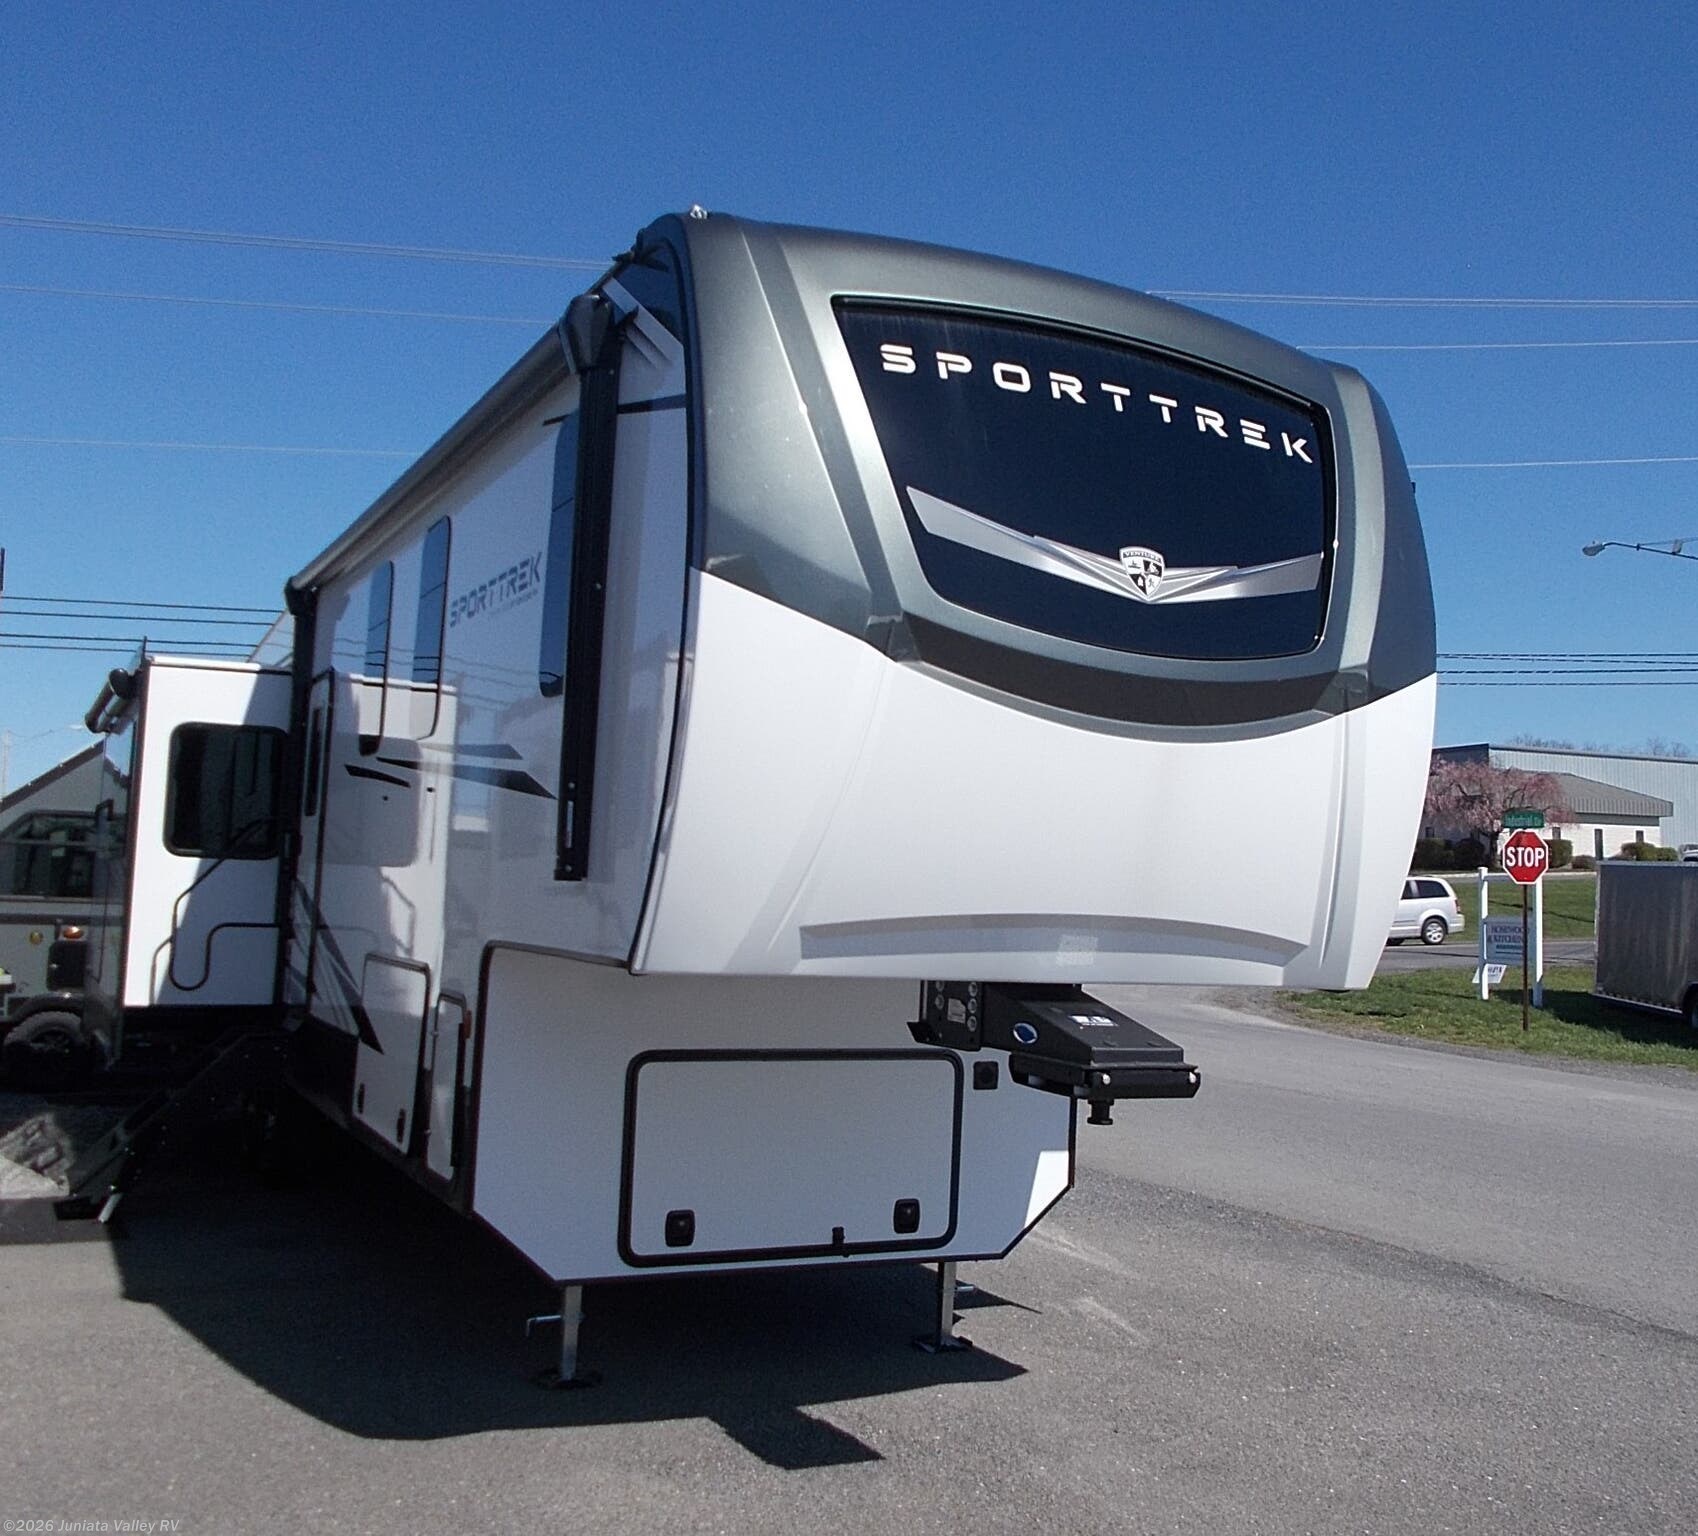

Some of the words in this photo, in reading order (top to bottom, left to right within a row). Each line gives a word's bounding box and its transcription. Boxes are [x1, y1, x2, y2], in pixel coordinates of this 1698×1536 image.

[879, 343, 1313, 464] SPORTTREK
[450, 551, 542, 627] SPORTTREK
[1506, 846, 1545, 867] STOP
